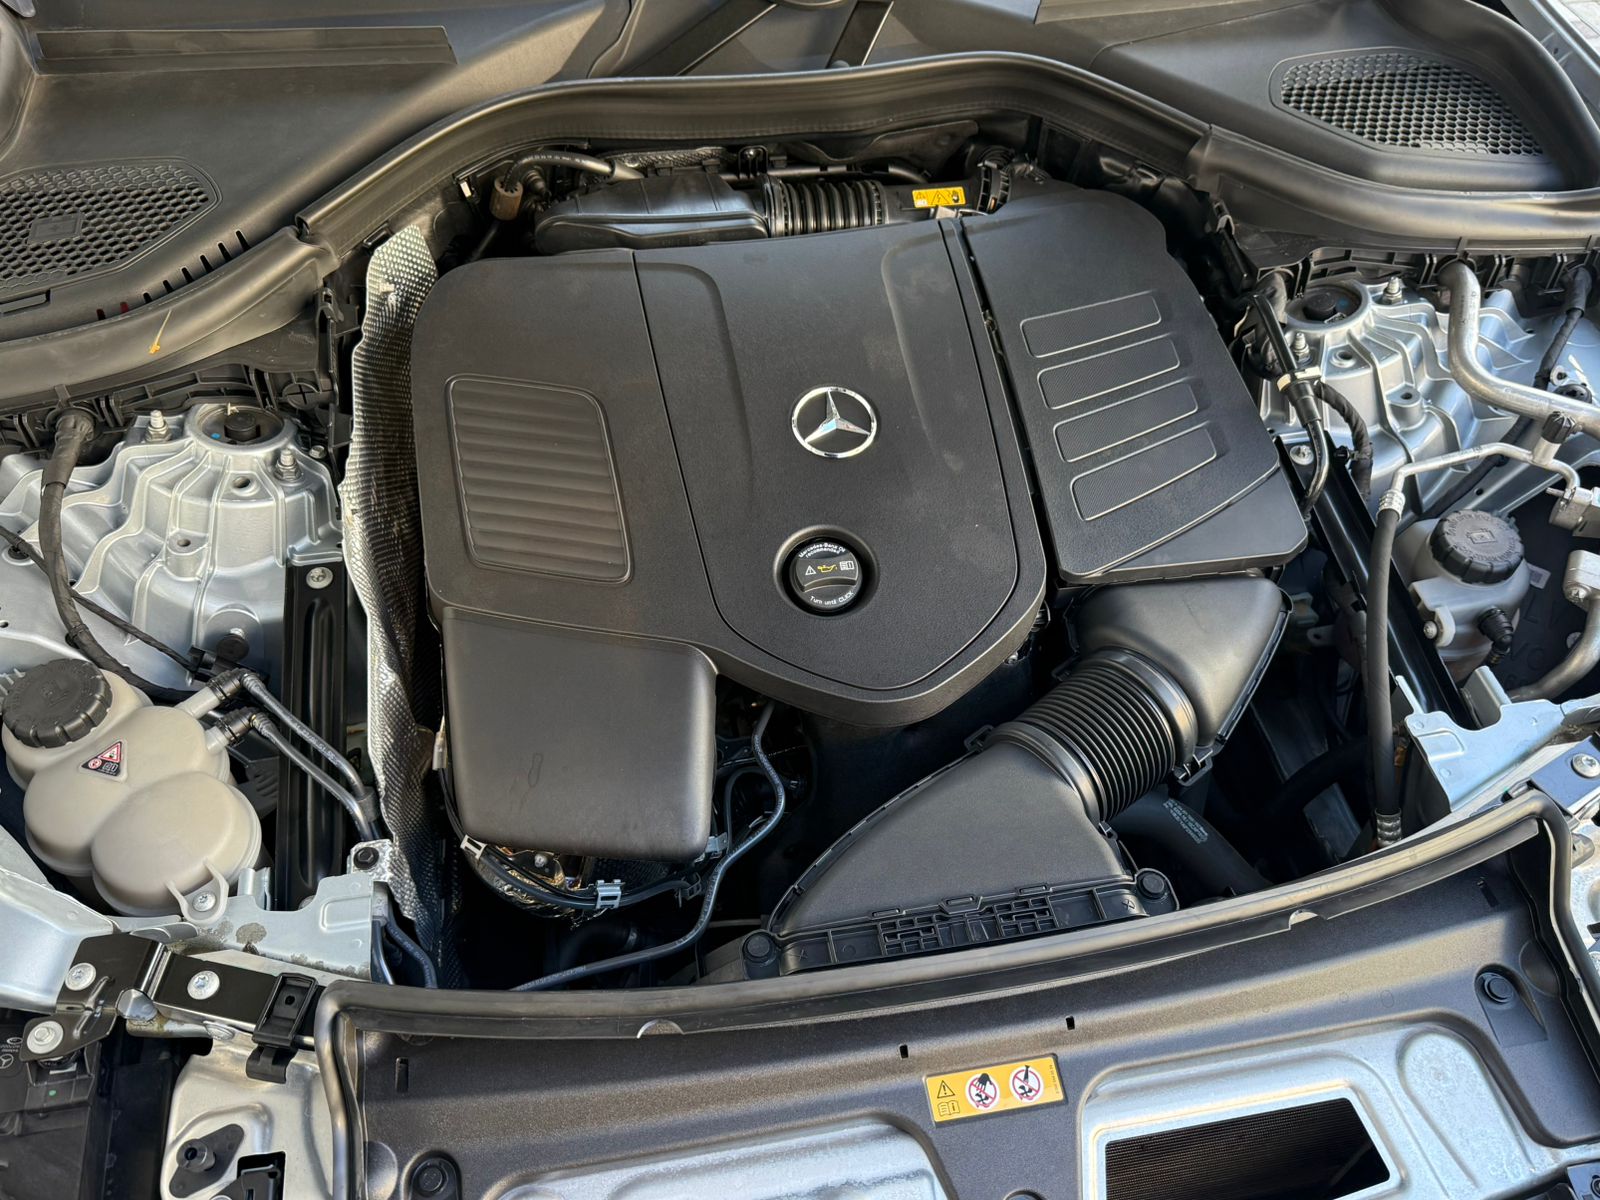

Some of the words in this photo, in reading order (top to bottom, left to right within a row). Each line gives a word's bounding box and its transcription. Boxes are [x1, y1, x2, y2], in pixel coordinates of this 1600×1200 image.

[798, 542, 838, 558] Mercedes-Benz
[805, 547, 840, 558] recommended
[810, 595, 823, 604] Turn
[838, 590, 854, 603] CLICK
